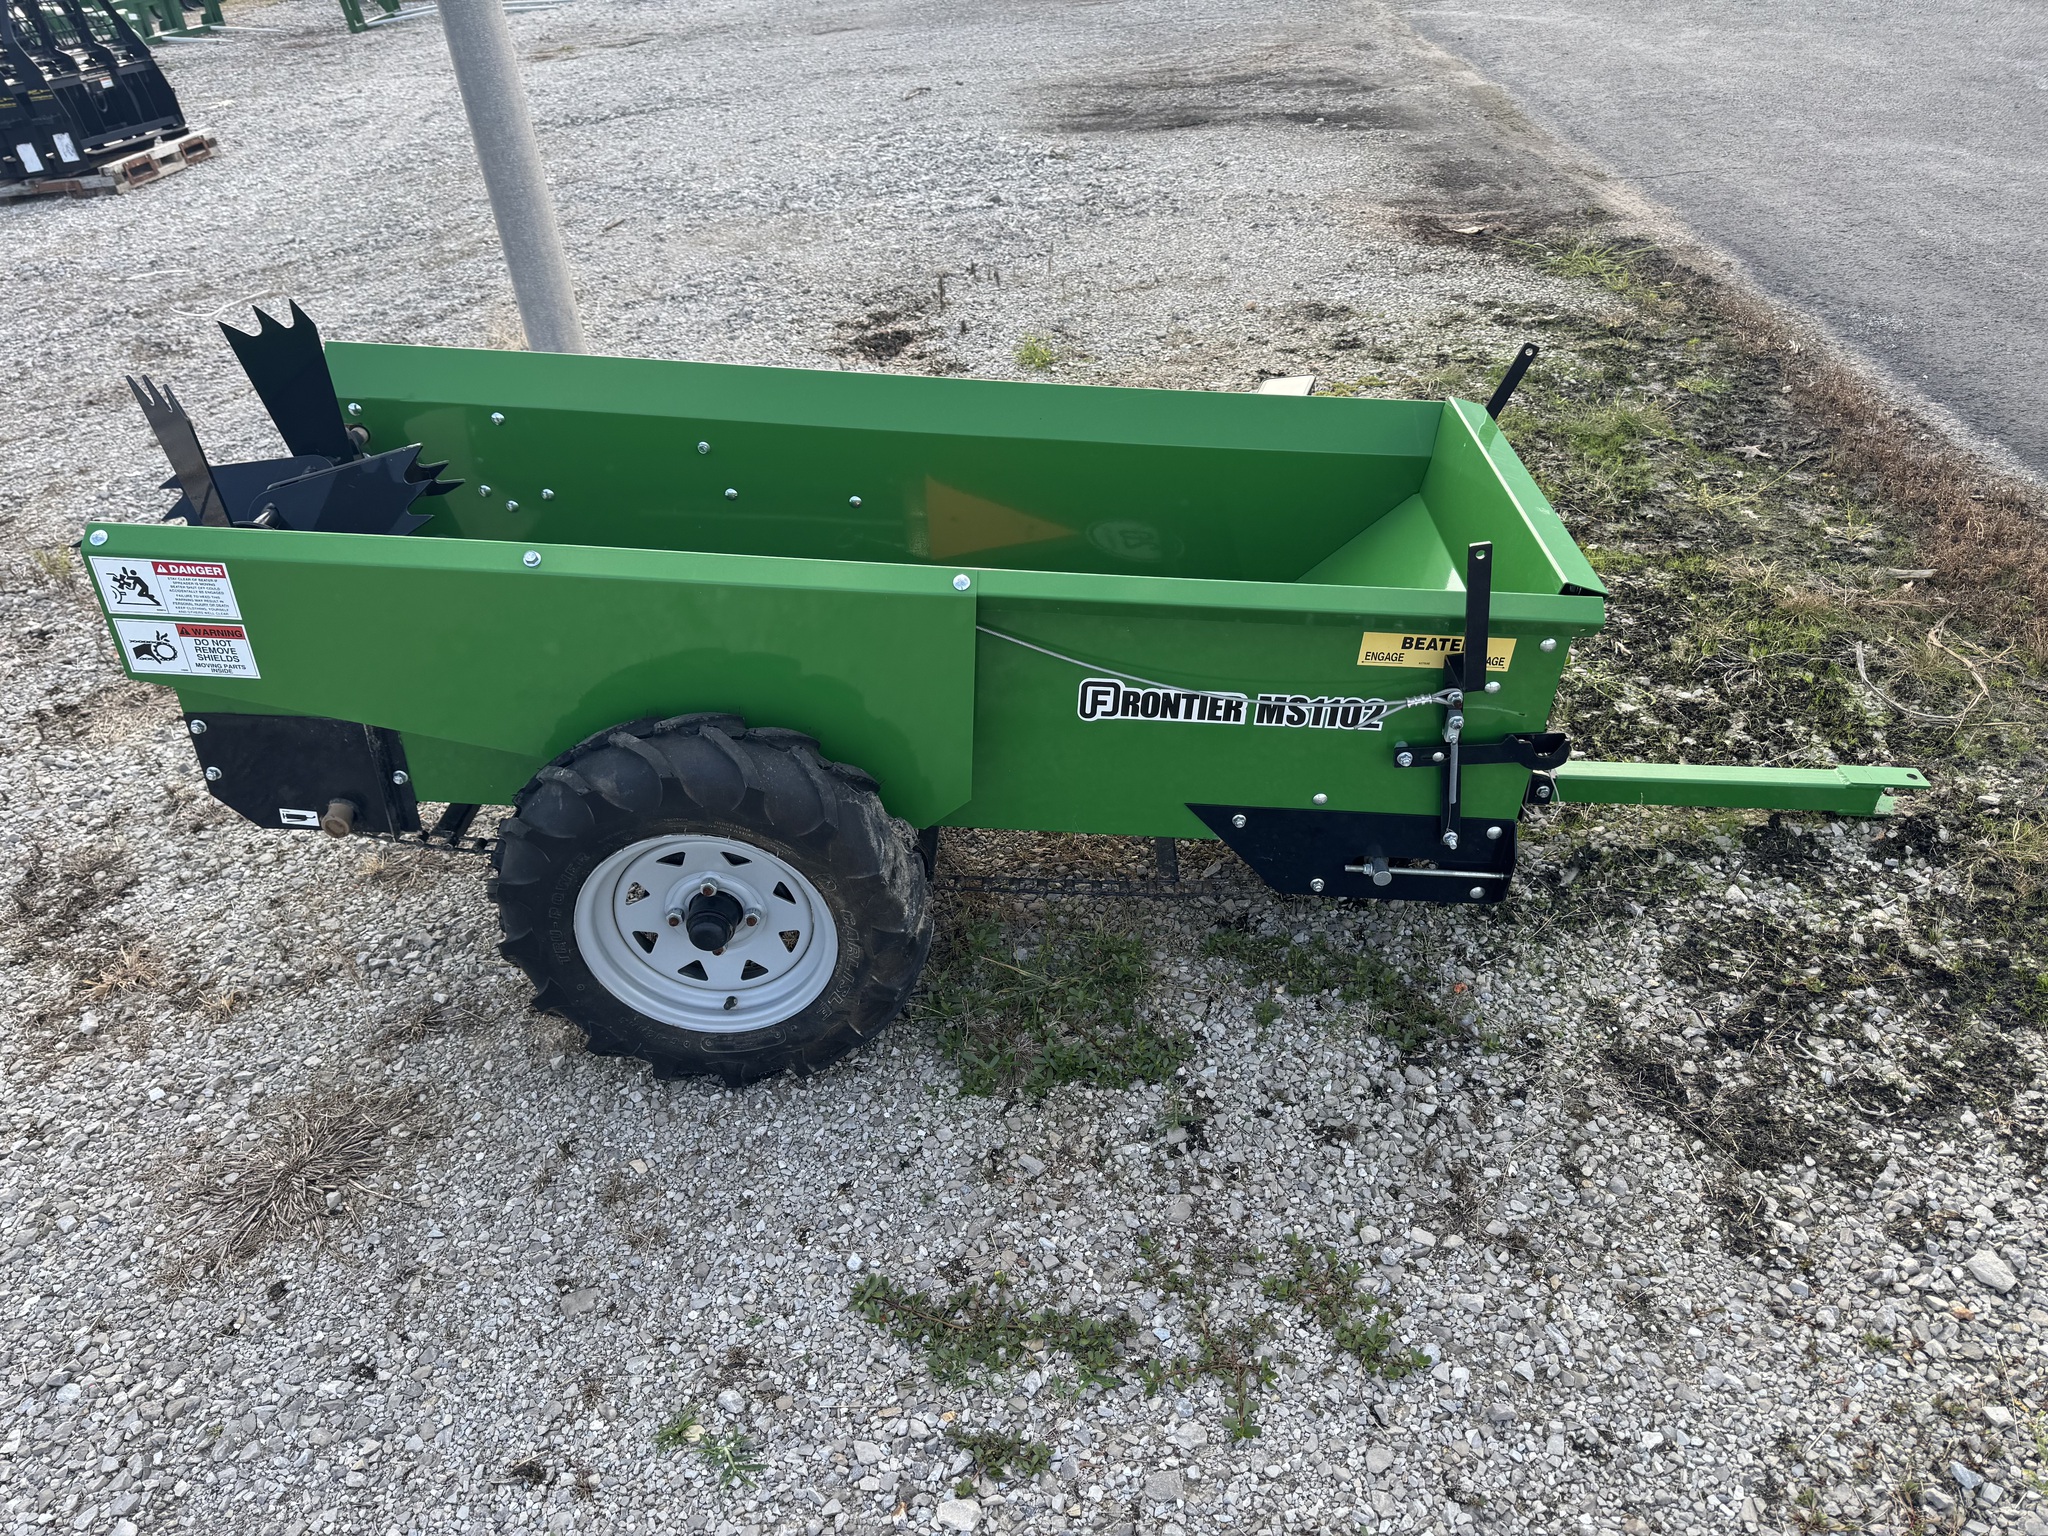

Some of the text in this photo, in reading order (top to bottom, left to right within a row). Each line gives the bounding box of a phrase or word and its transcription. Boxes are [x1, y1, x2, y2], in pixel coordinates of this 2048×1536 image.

[169, 564, 223, 576] DANGER
[191, 628, 243, 638] WARNING
[194, 638, 231, 647] DO NOT
[1401, 636, 1465, 652] BEATE
[194, 646, 237, 655] REMOVE
[197, 653, 240, 663] SHIELDS
[1364, 651, 1405, 662] ENGAGE
[1078, 679, 1387, 730] FRONTIER MS1102
[816, 909, 861, 1021] CARLISLE
